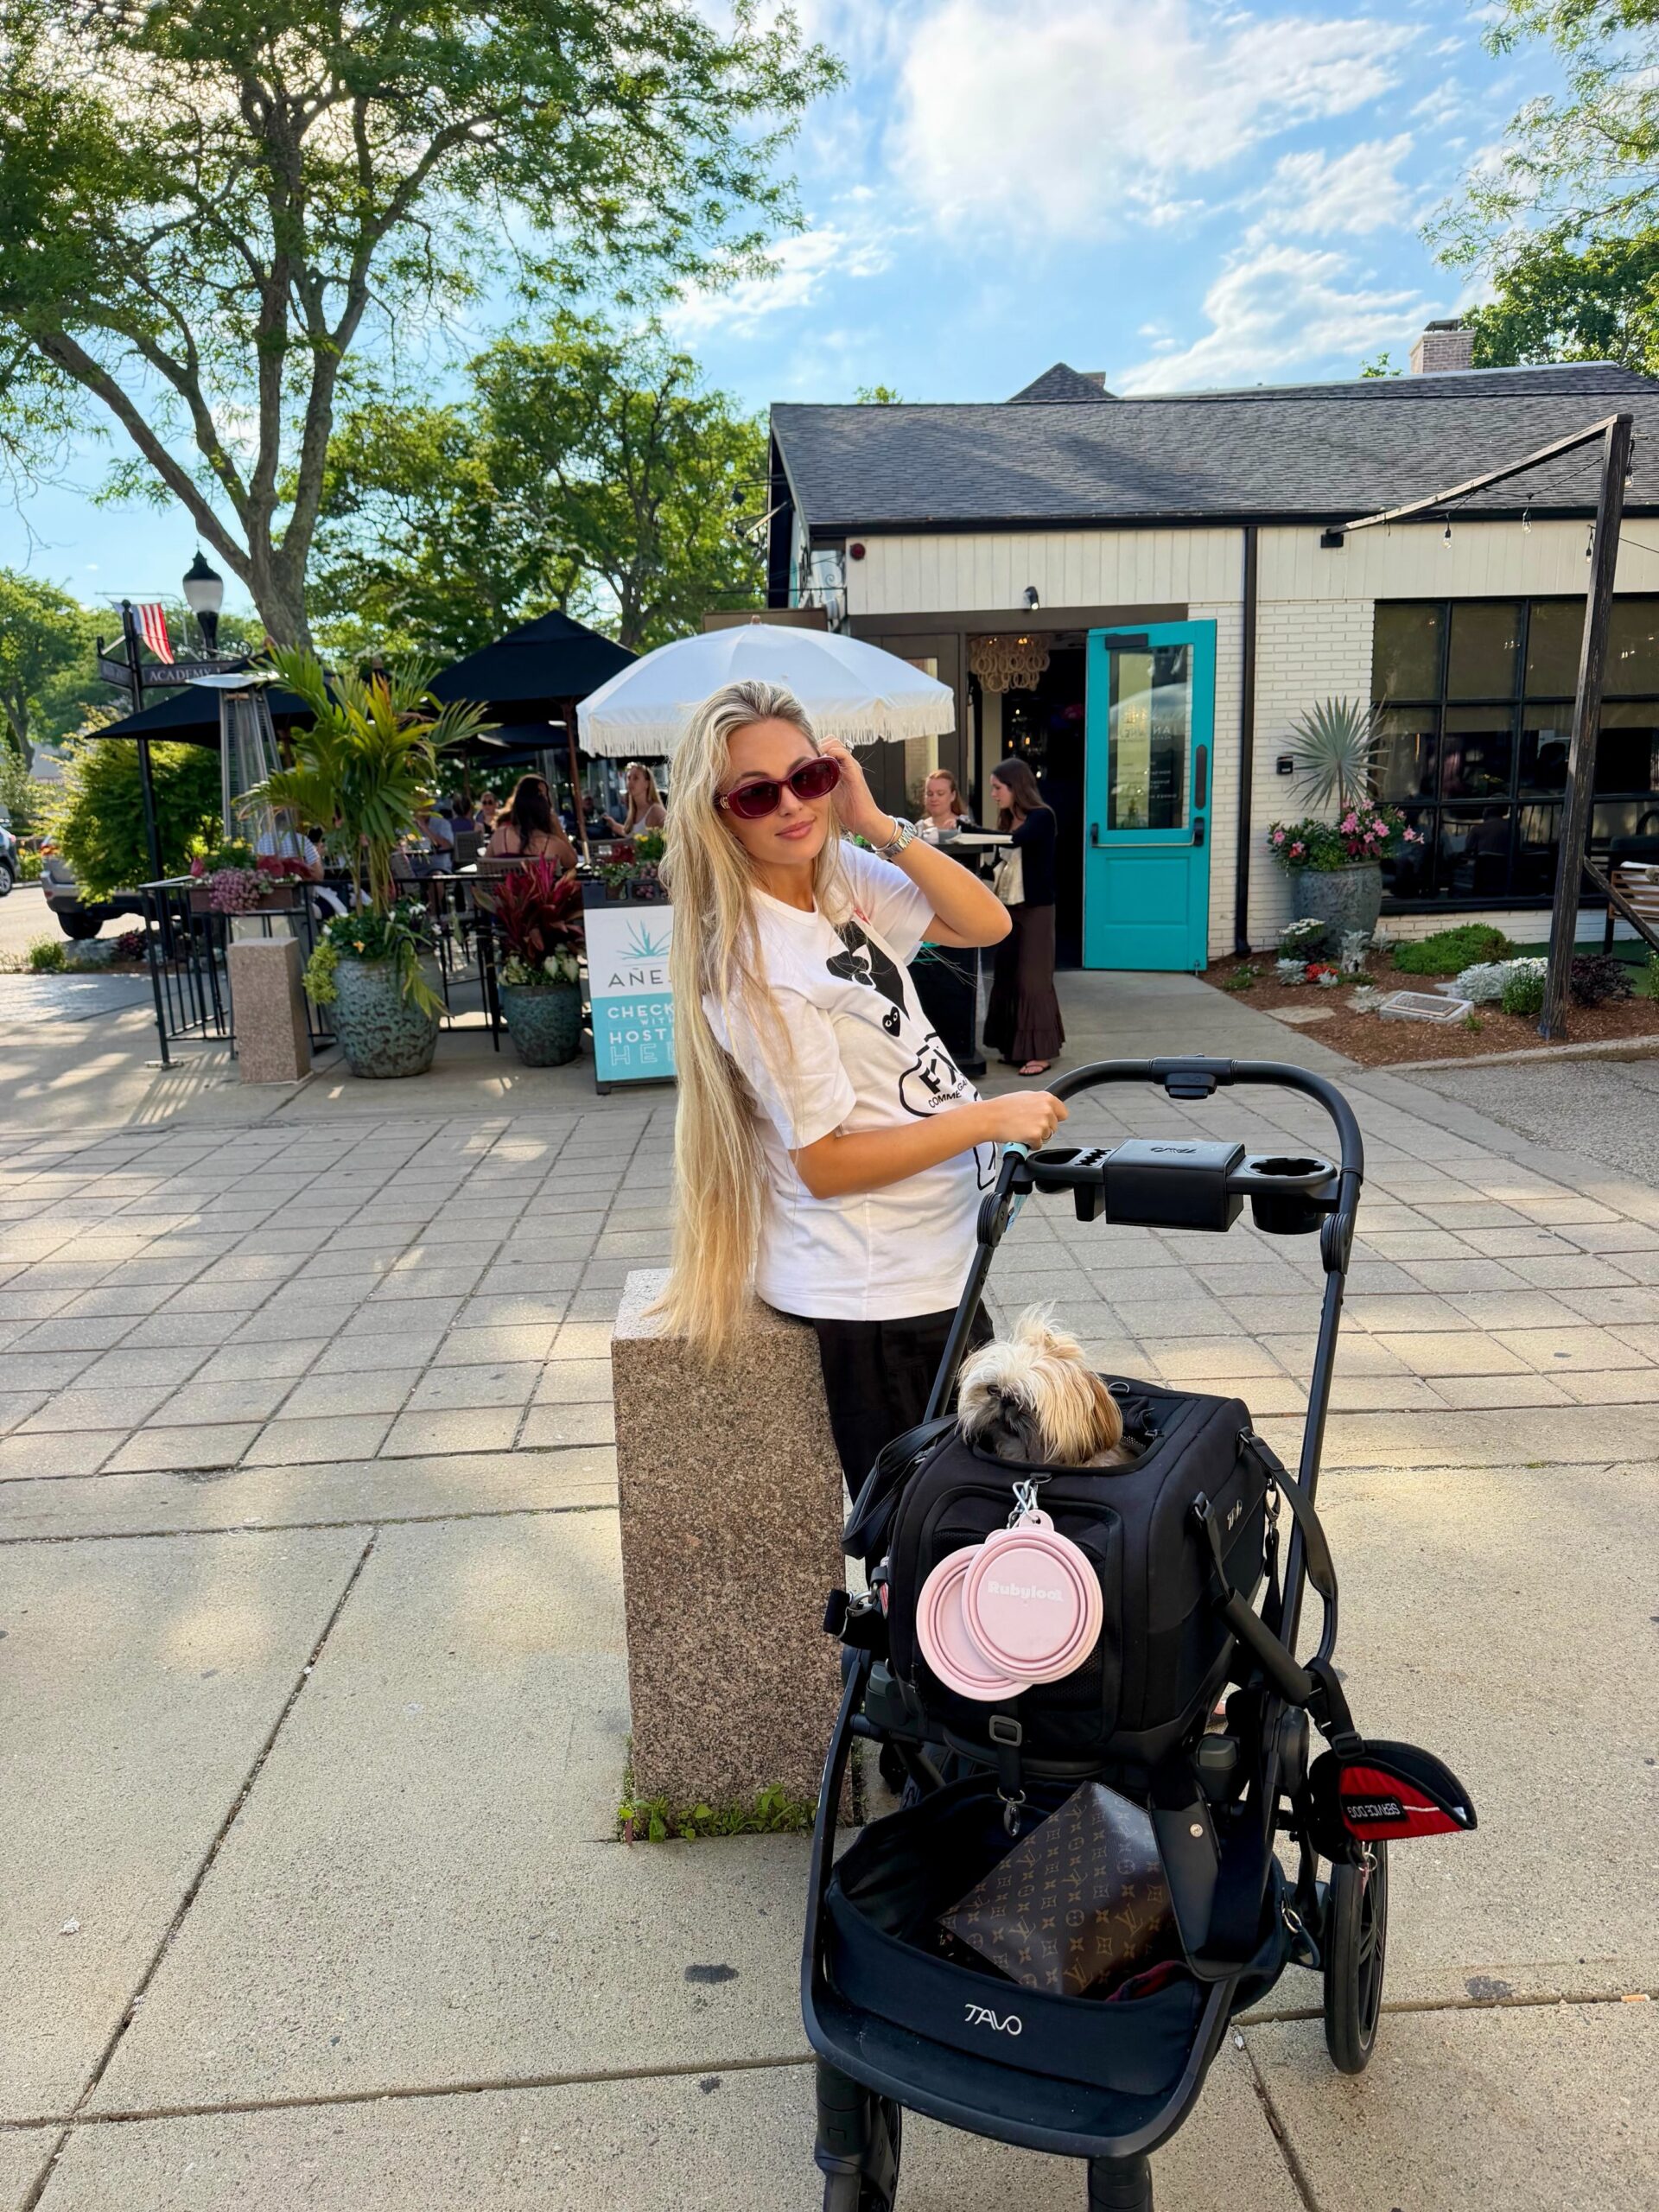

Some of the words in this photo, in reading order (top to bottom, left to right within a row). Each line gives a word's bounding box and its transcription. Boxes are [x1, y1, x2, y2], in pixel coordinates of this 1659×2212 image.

[607, 967, 671, 988] AÑE
[608, 1027, 674, 1045] HOST
[927, 1090, 962, 1109] COMME
[1346, 1805, 1368, 1819] DOG
[1365, 1802, 1401, 1818] SERVICE
[964, 2003, 1022, 2036] TAVO
